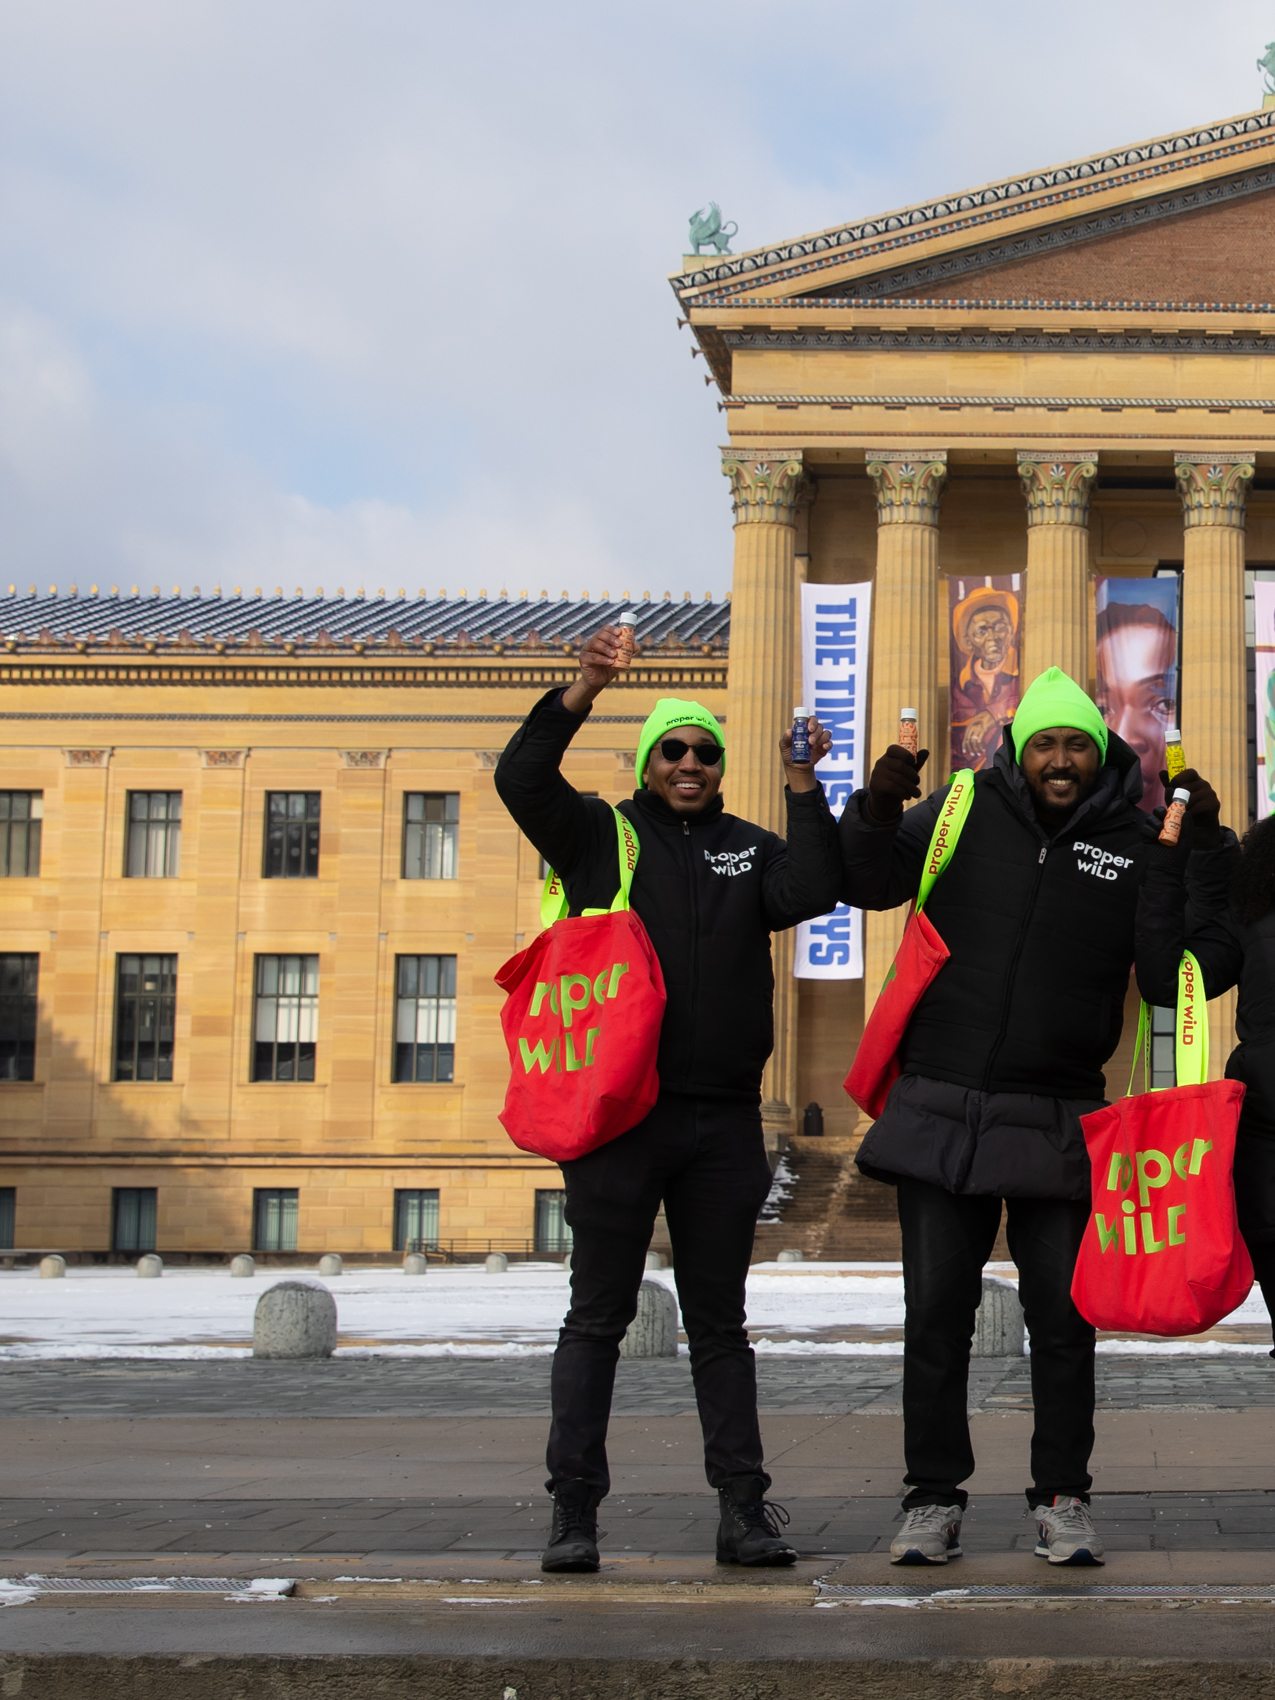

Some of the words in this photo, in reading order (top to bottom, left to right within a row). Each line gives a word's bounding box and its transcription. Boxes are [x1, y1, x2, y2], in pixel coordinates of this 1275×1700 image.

[815, 597, 857, 666] THE
[815, 673, 855, 760] TIME
[815, 770, 854, 807] IS
